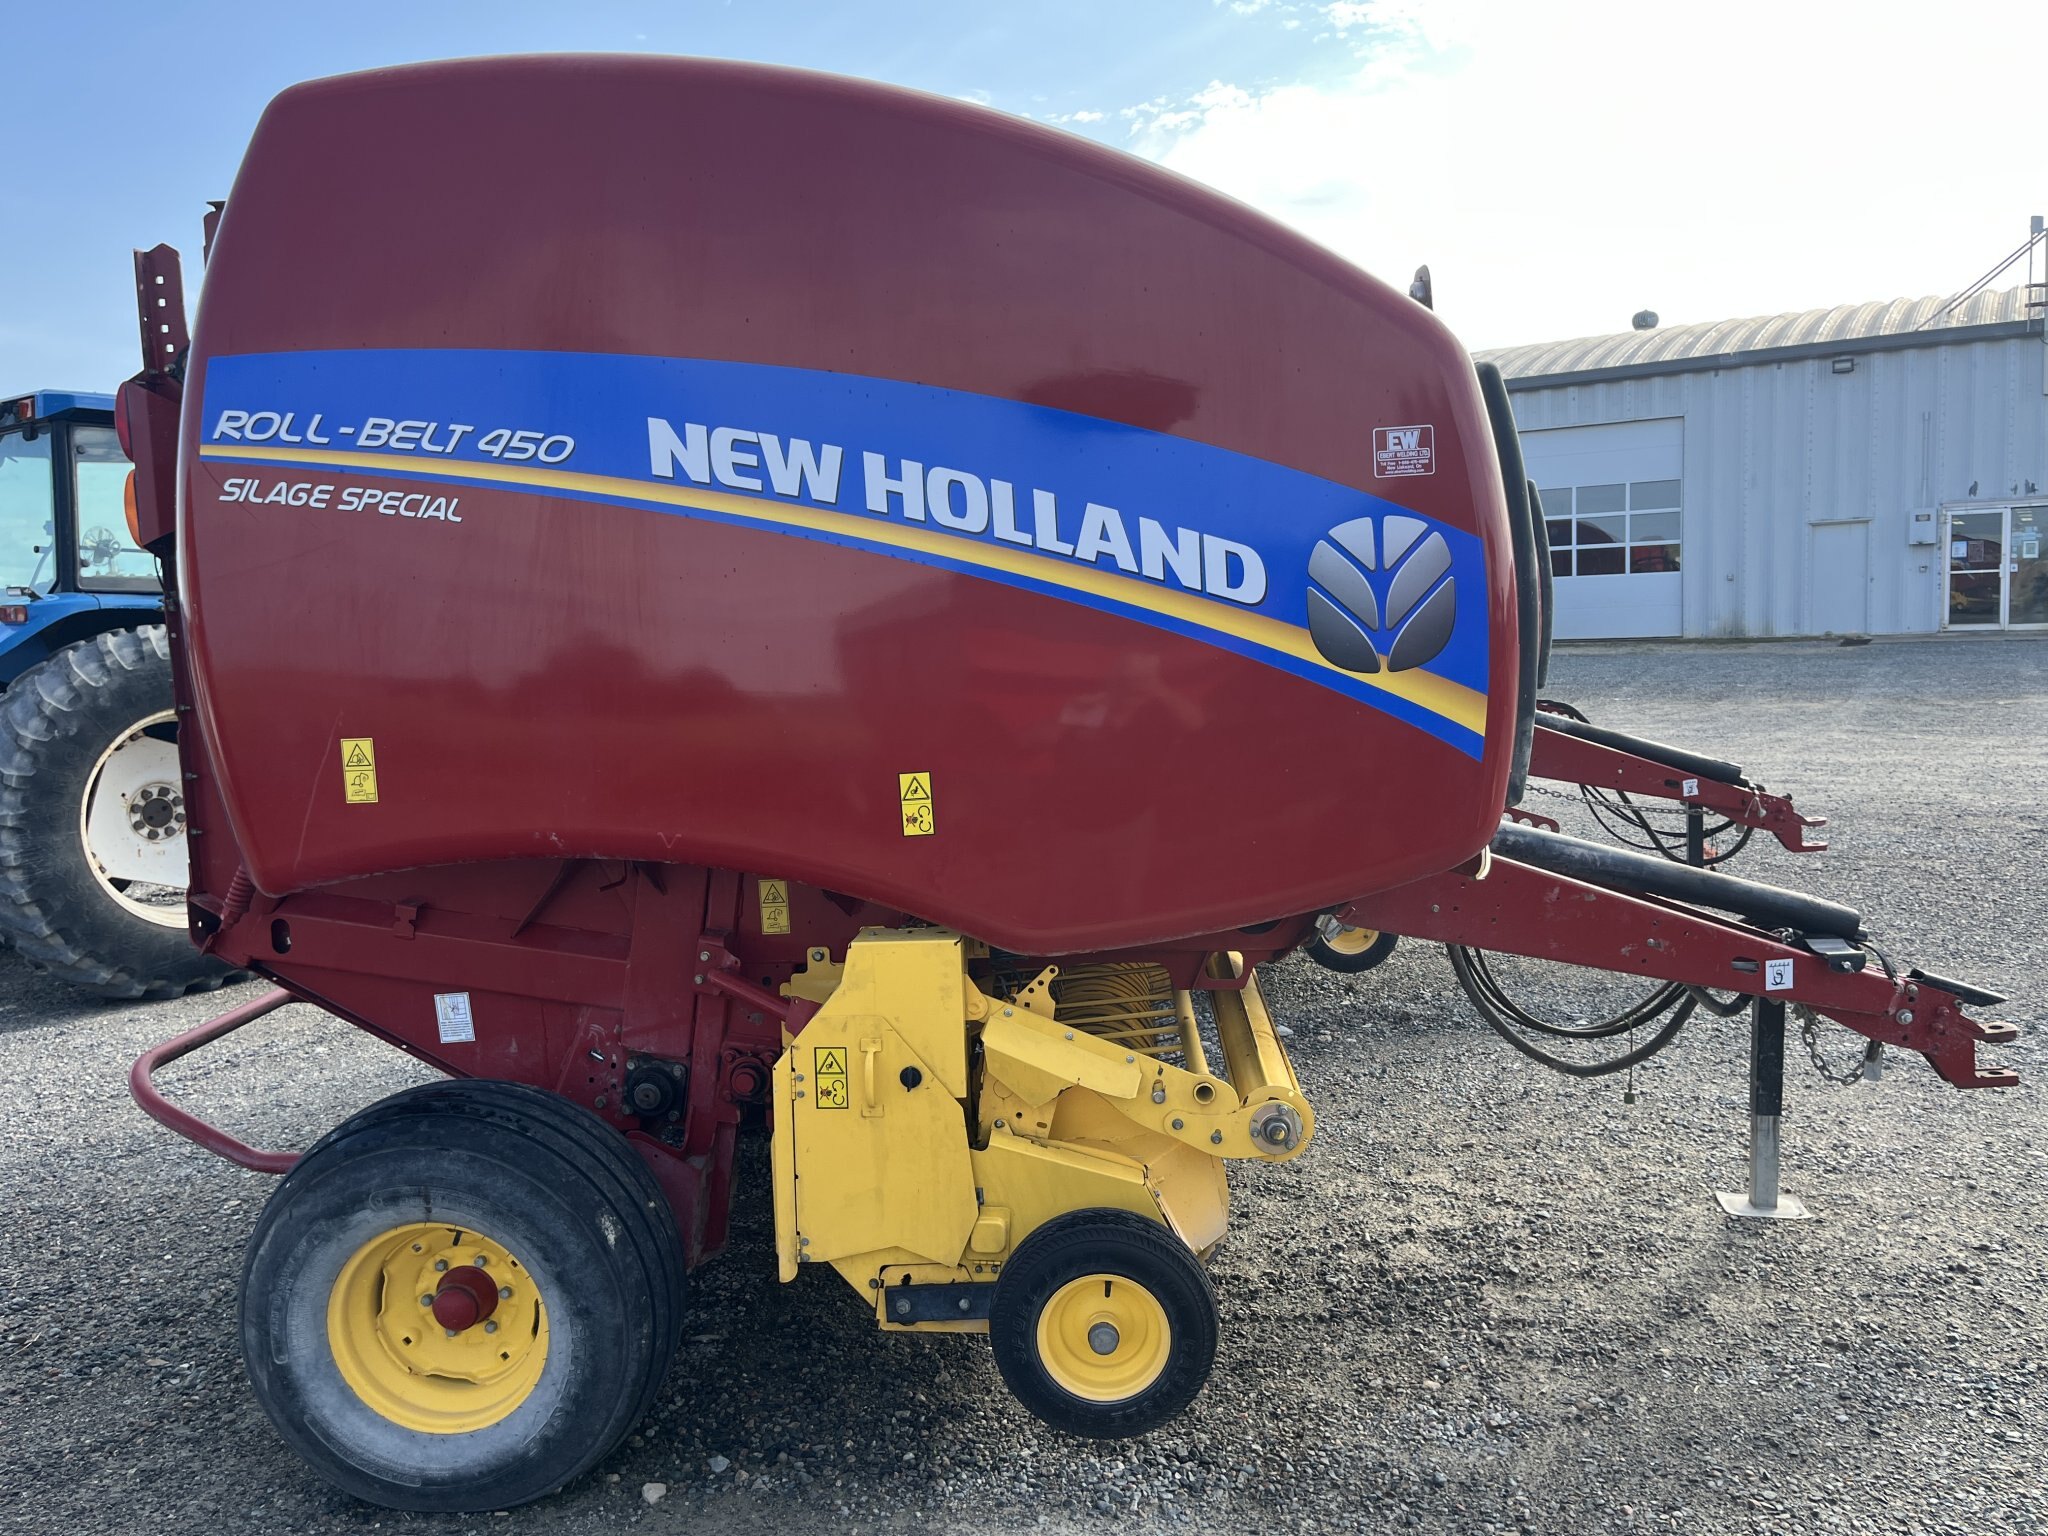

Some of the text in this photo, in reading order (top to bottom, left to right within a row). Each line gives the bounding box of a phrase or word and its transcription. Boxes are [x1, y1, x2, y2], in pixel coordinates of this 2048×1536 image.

[477, 428, 575, 463] 450
[1388, 430, 1419, 451] EW
[219, 477, 464, 522] SILAGE SPECIAL
[647, 416, 1267, 605] NEW HOLLAND
